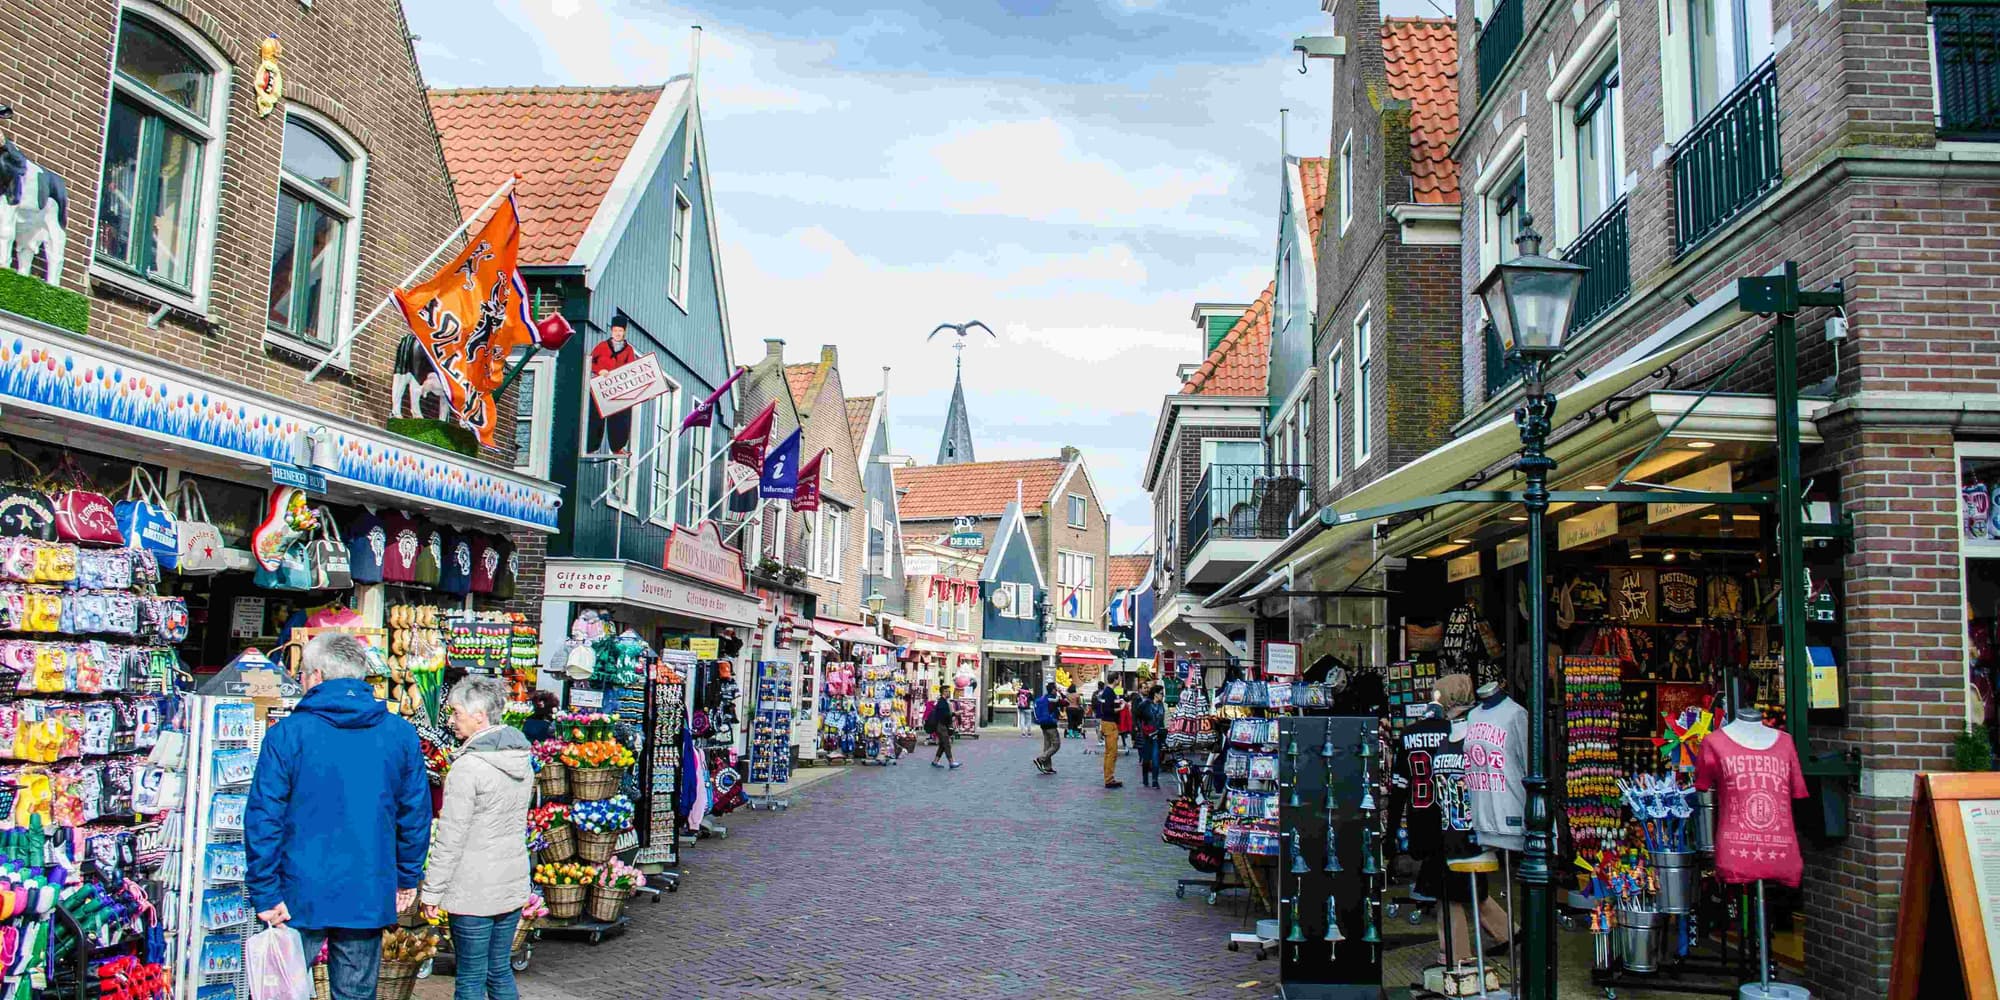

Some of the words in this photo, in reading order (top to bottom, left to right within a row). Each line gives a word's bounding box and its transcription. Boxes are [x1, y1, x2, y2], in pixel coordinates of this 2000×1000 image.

[598, 366, 637, 389] FOTO'S
[639, 361, 653, 373] IN
[601, 371, 656, 399] KOSTUUM
[763, 485, 794, 493] Informatie
[950, 537, 962, 546] DE
[964, 537, 983, 546] KOE
[675, 540, 699, 567] FOTO'S
[557, 572, 611, 582] Giftshop
[560, 582, 574, 590] de
[580, 582, 608, 590] Boer
[642, 580, 672, 599] Souvenirs
[1068, 633, 1081, 641] Fish
[1090, 635, 1107, 645] Chips
[1408, 751, 1435, 808] 8
[1736, 772, 1782, 792] CITY
